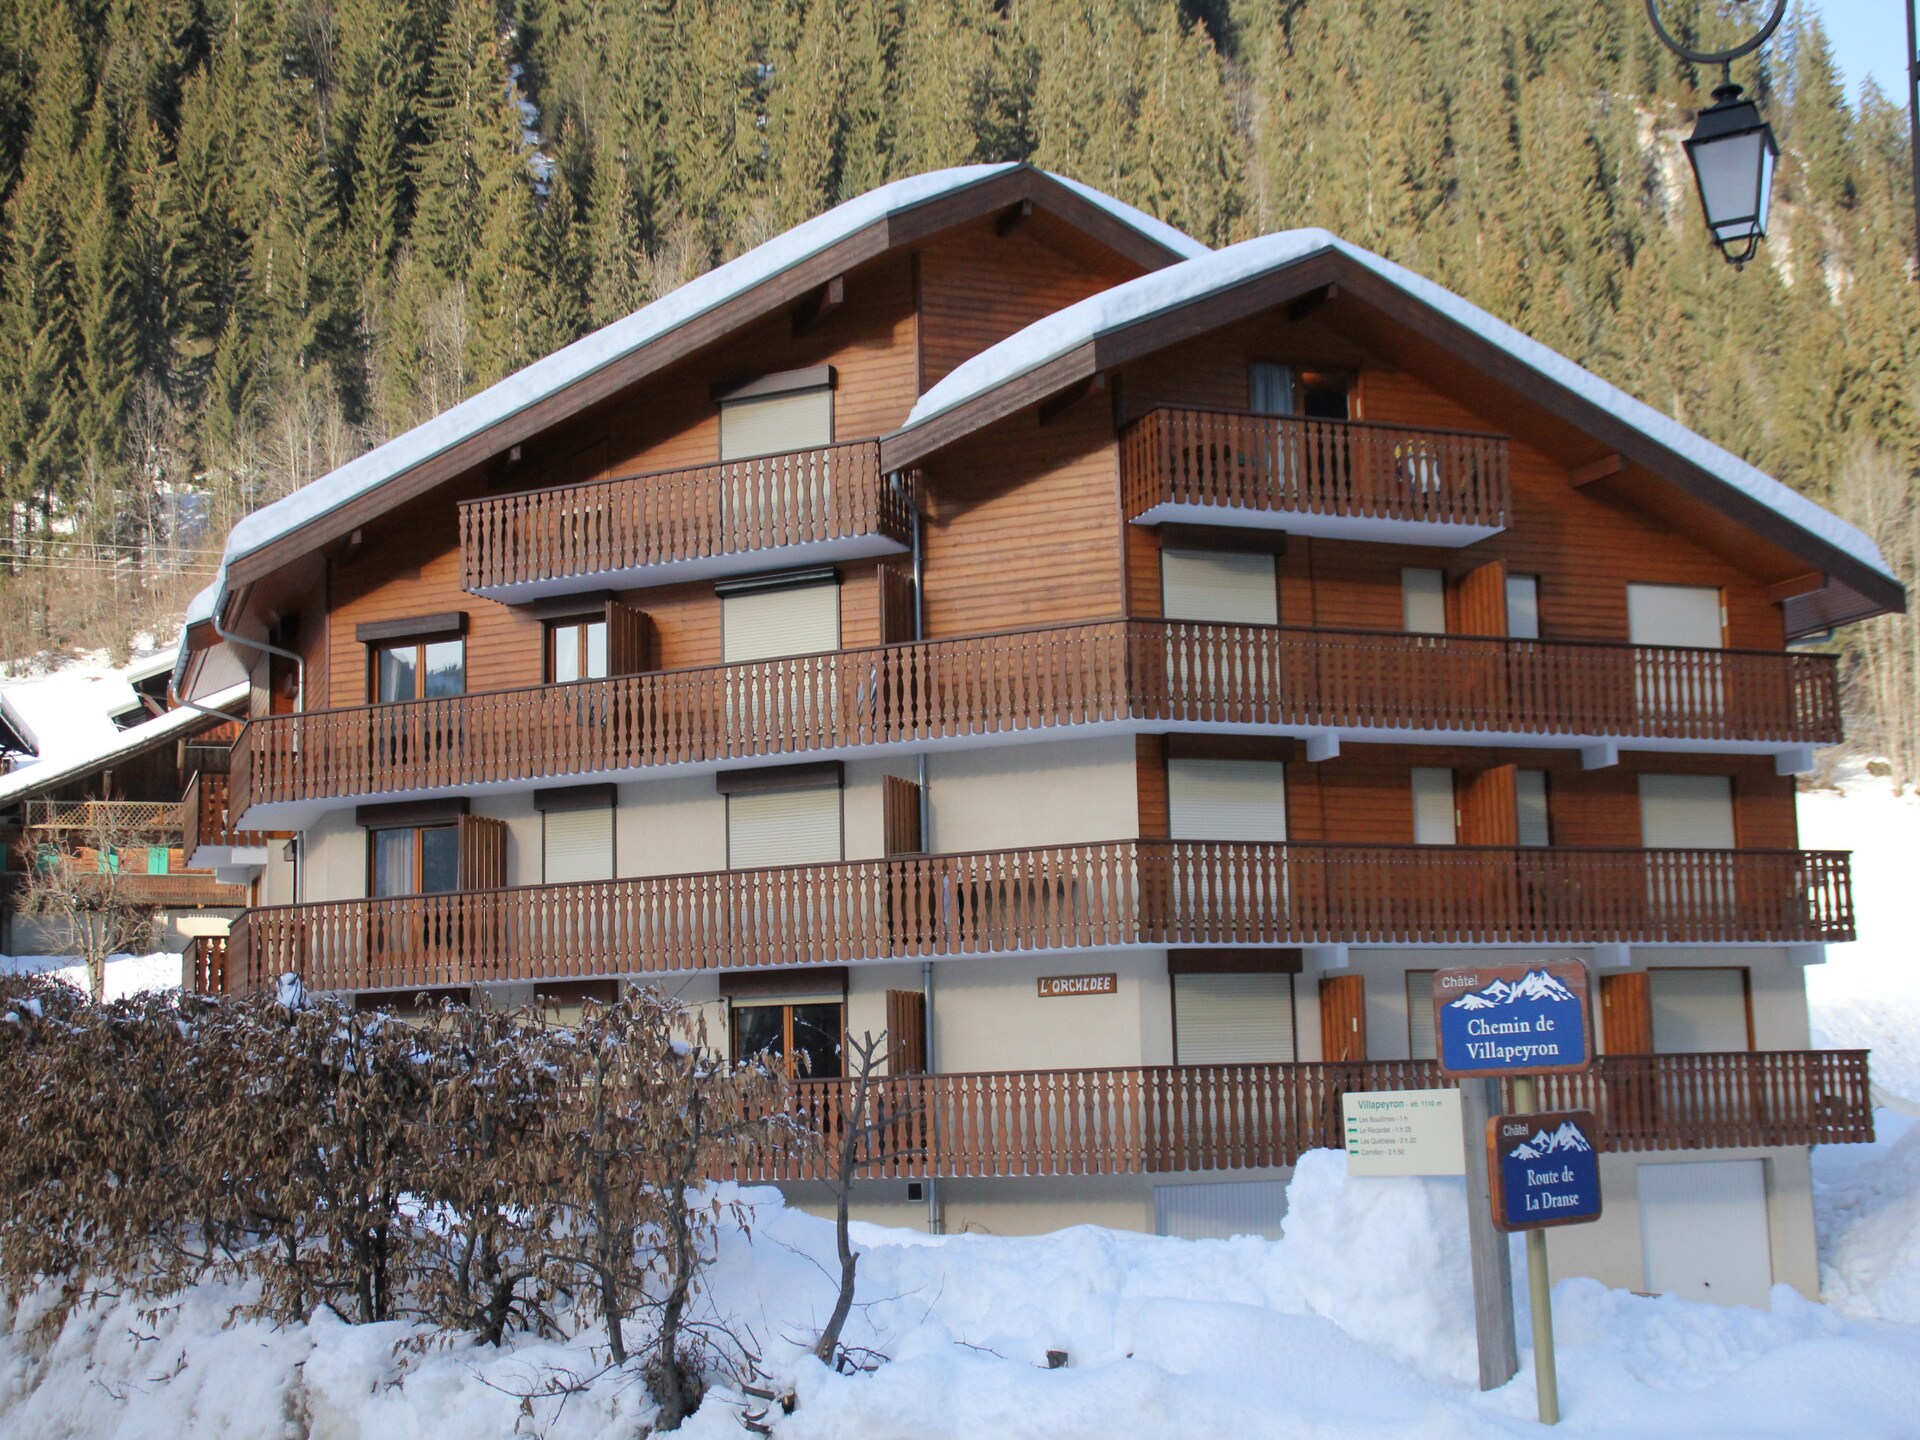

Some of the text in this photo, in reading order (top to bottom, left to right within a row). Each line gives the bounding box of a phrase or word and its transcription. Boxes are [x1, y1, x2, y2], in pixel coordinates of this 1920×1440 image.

[1040, 977, 1111, 993] L'ORCHIDEE
[1441, 975, 1478, 989] Châtel
[1467, 1014, 1555, 1036] Chemin de
[1466, 1041, 1560, 1062] Villapeyron
[1358, 1100, 1404, 1110] Villapeyron
[1503, 1123, 1529, 1137] Châtel
[1526, 1165, 1575, 1187] Route de
[1525, 1191, 1580, 1211] La Dranse
